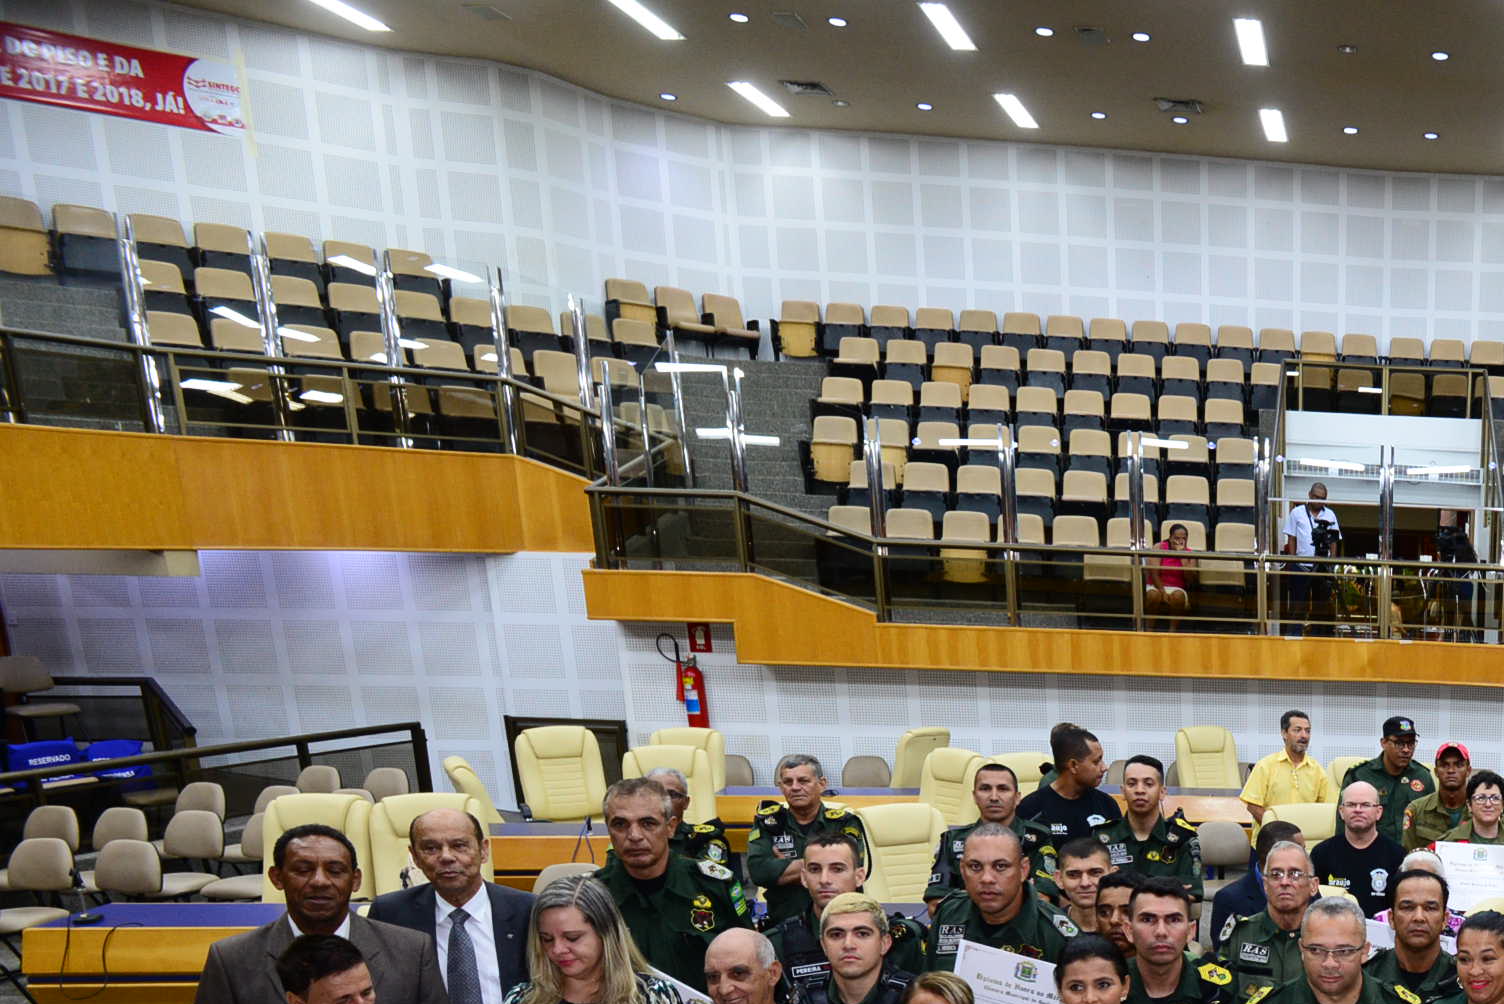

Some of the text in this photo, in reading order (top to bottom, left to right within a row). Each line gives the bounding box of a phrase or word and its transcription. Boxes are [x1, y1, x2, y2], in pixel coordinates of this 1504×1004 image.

[41, 43, 92, 68] PISO
[98, 53, 110, 72] E
[114, 55, 144, 79] DA
[17, 67, 69, 95] 2017
[74, 79, 90, 98] E
[90, 82, 152, 111] 2018,
[155, 91, 186, 115] JÁ!
[29, 754, 71, 766] RESERVADO
[1243, 944, 1267, 955] RAS
